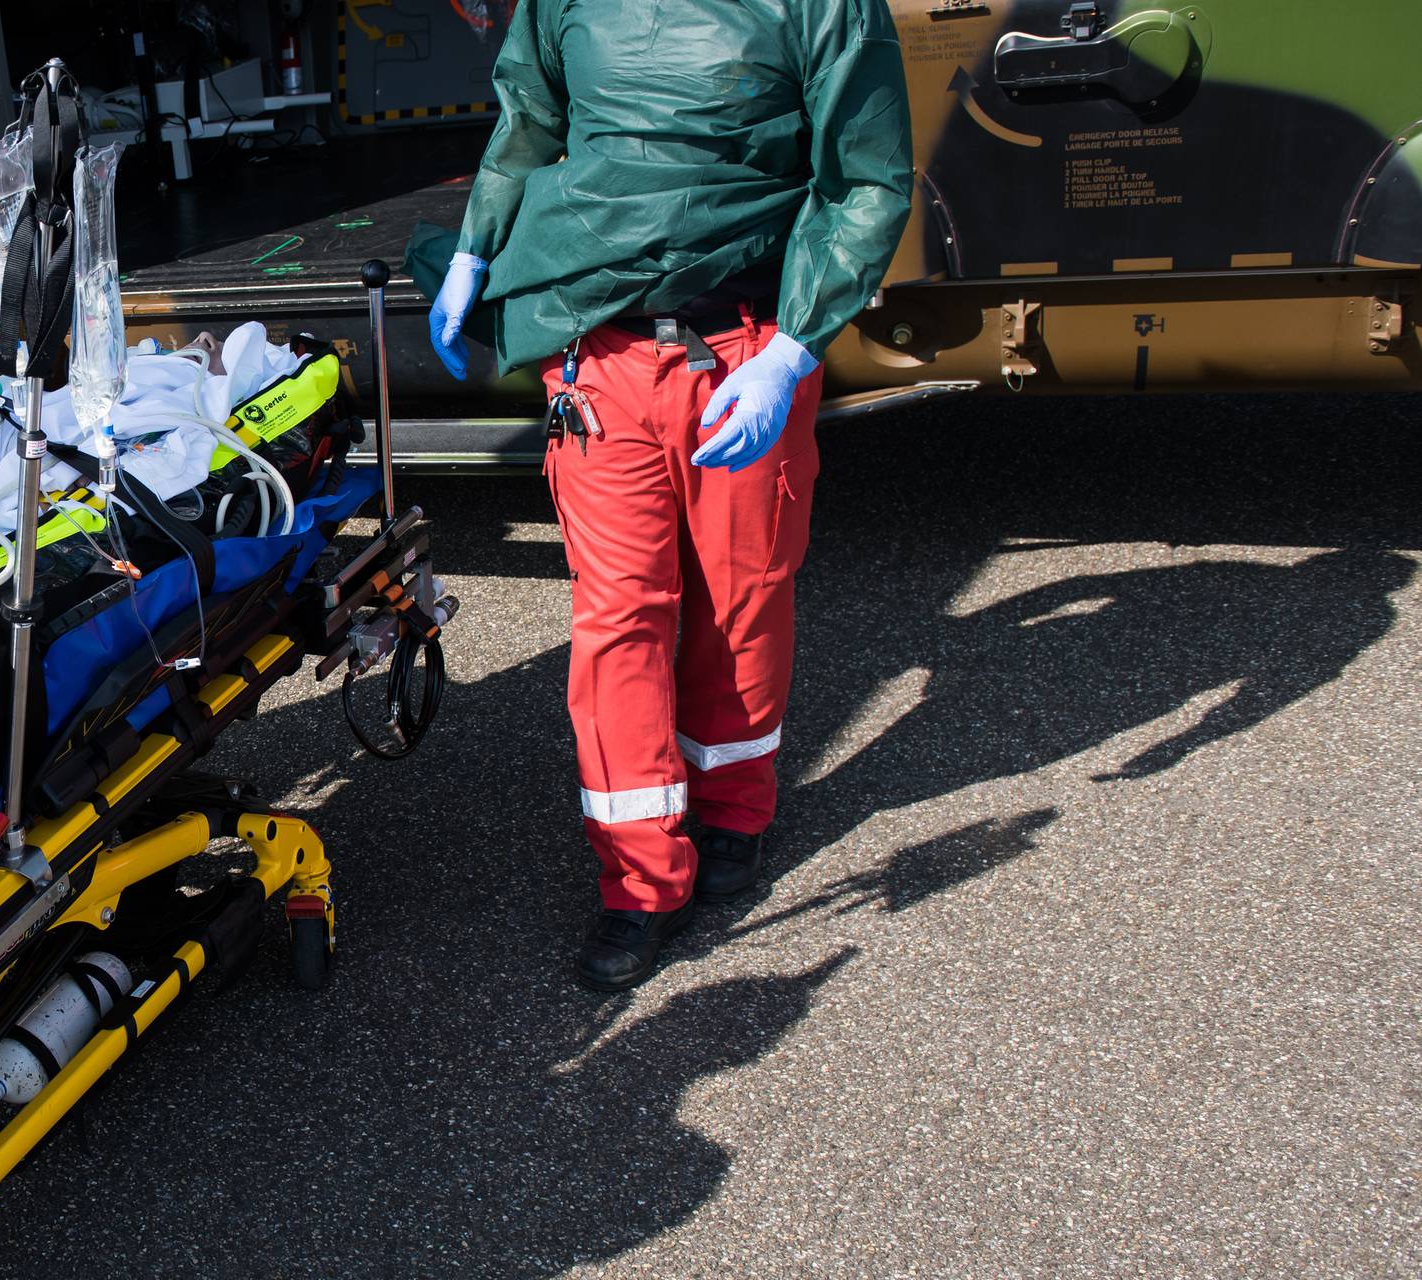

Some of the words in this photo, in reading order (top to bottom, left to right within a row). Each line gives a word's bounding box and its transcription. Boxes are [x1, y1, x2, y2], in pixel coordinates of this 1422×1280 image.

[1069, 132, 1115, 141] EMERGENCY
[1118, 129, 1140, 138] DOOR
[1143, 128, 1179, 136] RELEASE
[1065, 141, 1101, 151] LARGAGE
[1104, 140, 1130, 148] PORTE
[1146, 137, 1183, 145] SECOURS
[1094, 158, 1112, 166] CLIP
[1095, 166, 1126, 174] HANDLE
[1093, 174, 1115, 183] DOOR
[1072, 183, 1106, 192] POUSSER
[1109, 182, 1118, 190] LE
[1109, 190, 1119, 198] LA
[1143, 197, 1153, 205] LA
[1155, 196, 1183, 204] PORTE
[264, 392, 288, 411] certec
